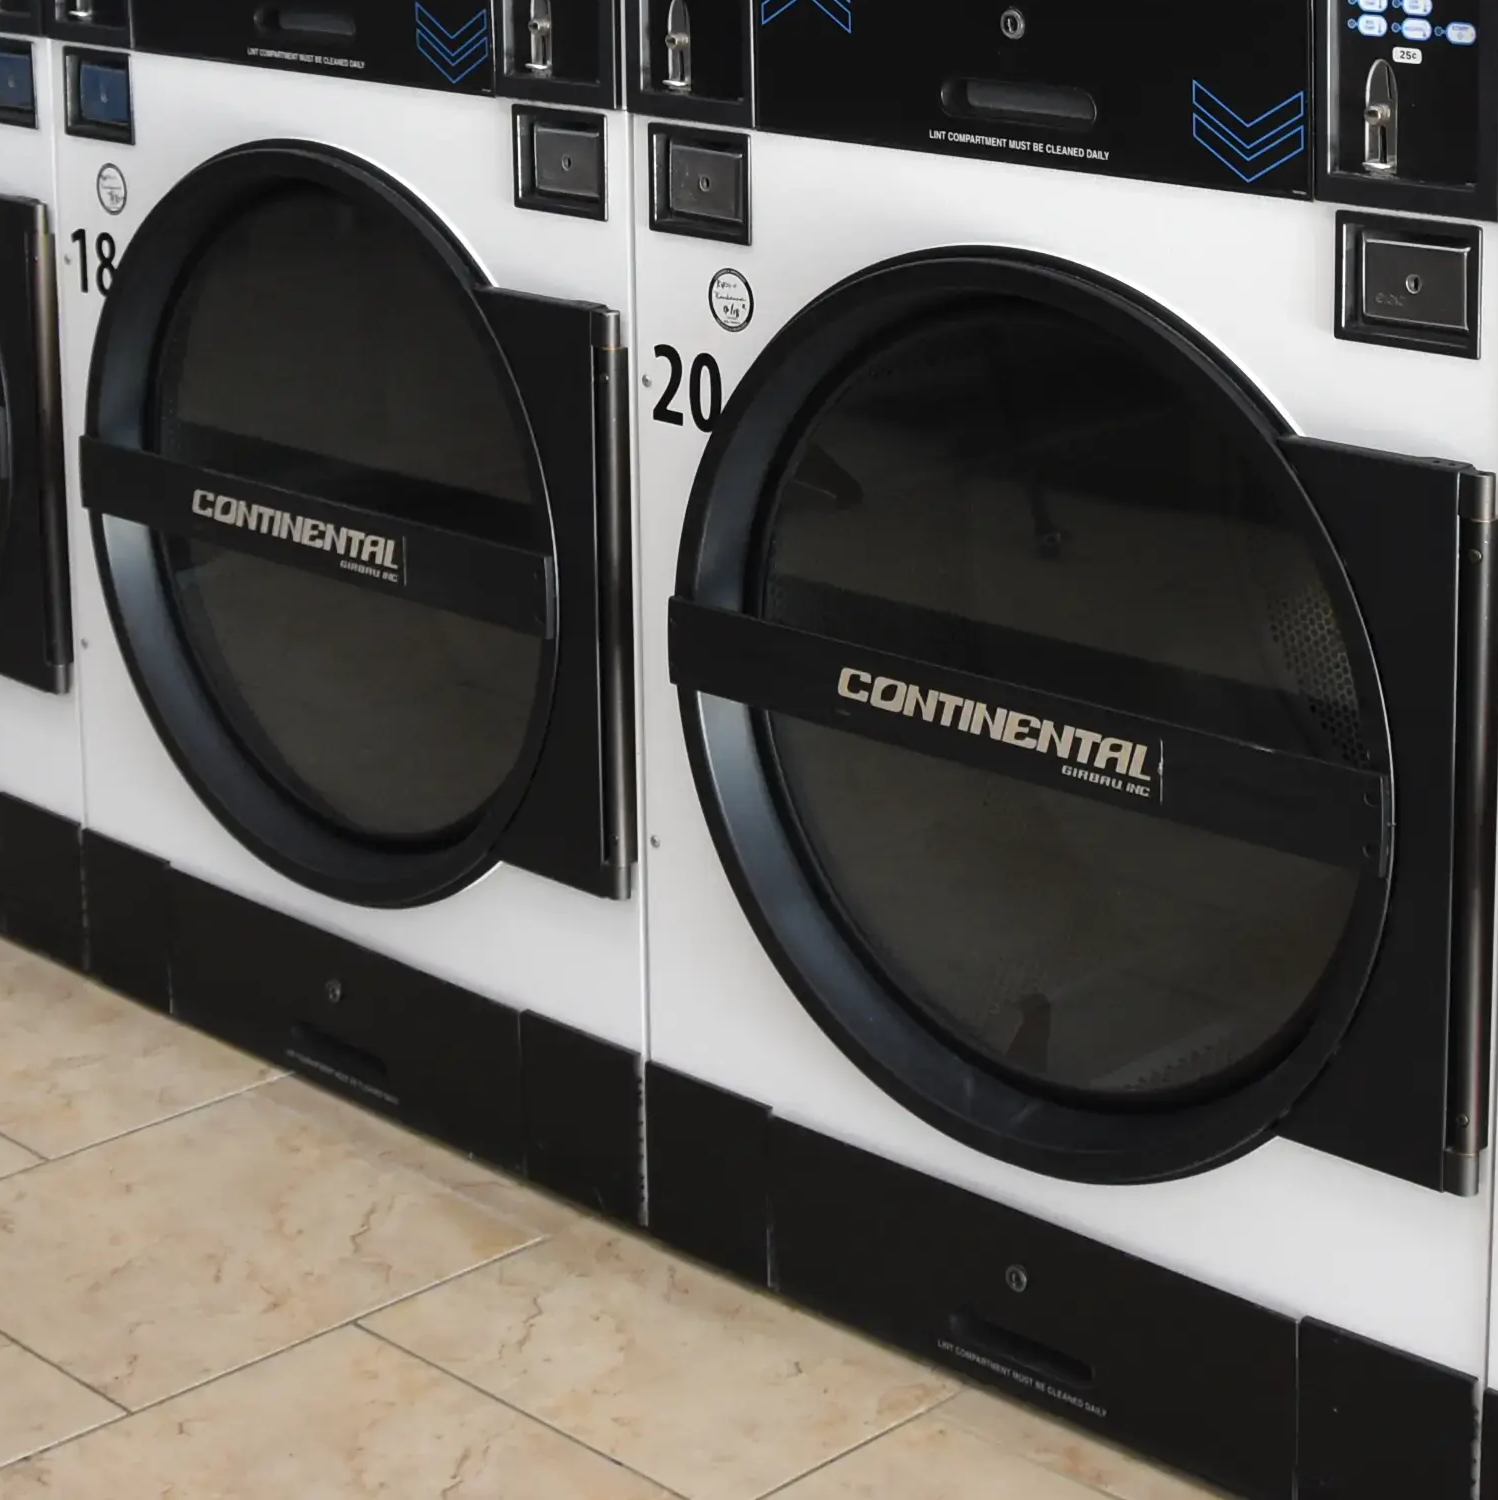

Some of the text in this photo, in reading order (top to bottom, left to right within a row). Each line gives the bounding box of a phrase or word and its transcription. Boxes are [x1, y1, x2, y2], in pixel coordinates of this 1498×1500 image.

[929, 129, 1110, 162] LINT COMPARTMENT MUST BE CLEANED DAILY
[71, 228, 116, 298] 18
[653, 344, 723, 433] 20
[191, 488, 399, 570] CONTINENTAL
[837, 666, 1152, 782] CONTINENTAL
[955, 1346, 1012, 1378] COMPARTMENT
[1012, 1371, 1034, 1387] MUST
[1047, 1385, 1085, 1409] CLEANED
[1085, 1401, 1108, 1418] DAILY
